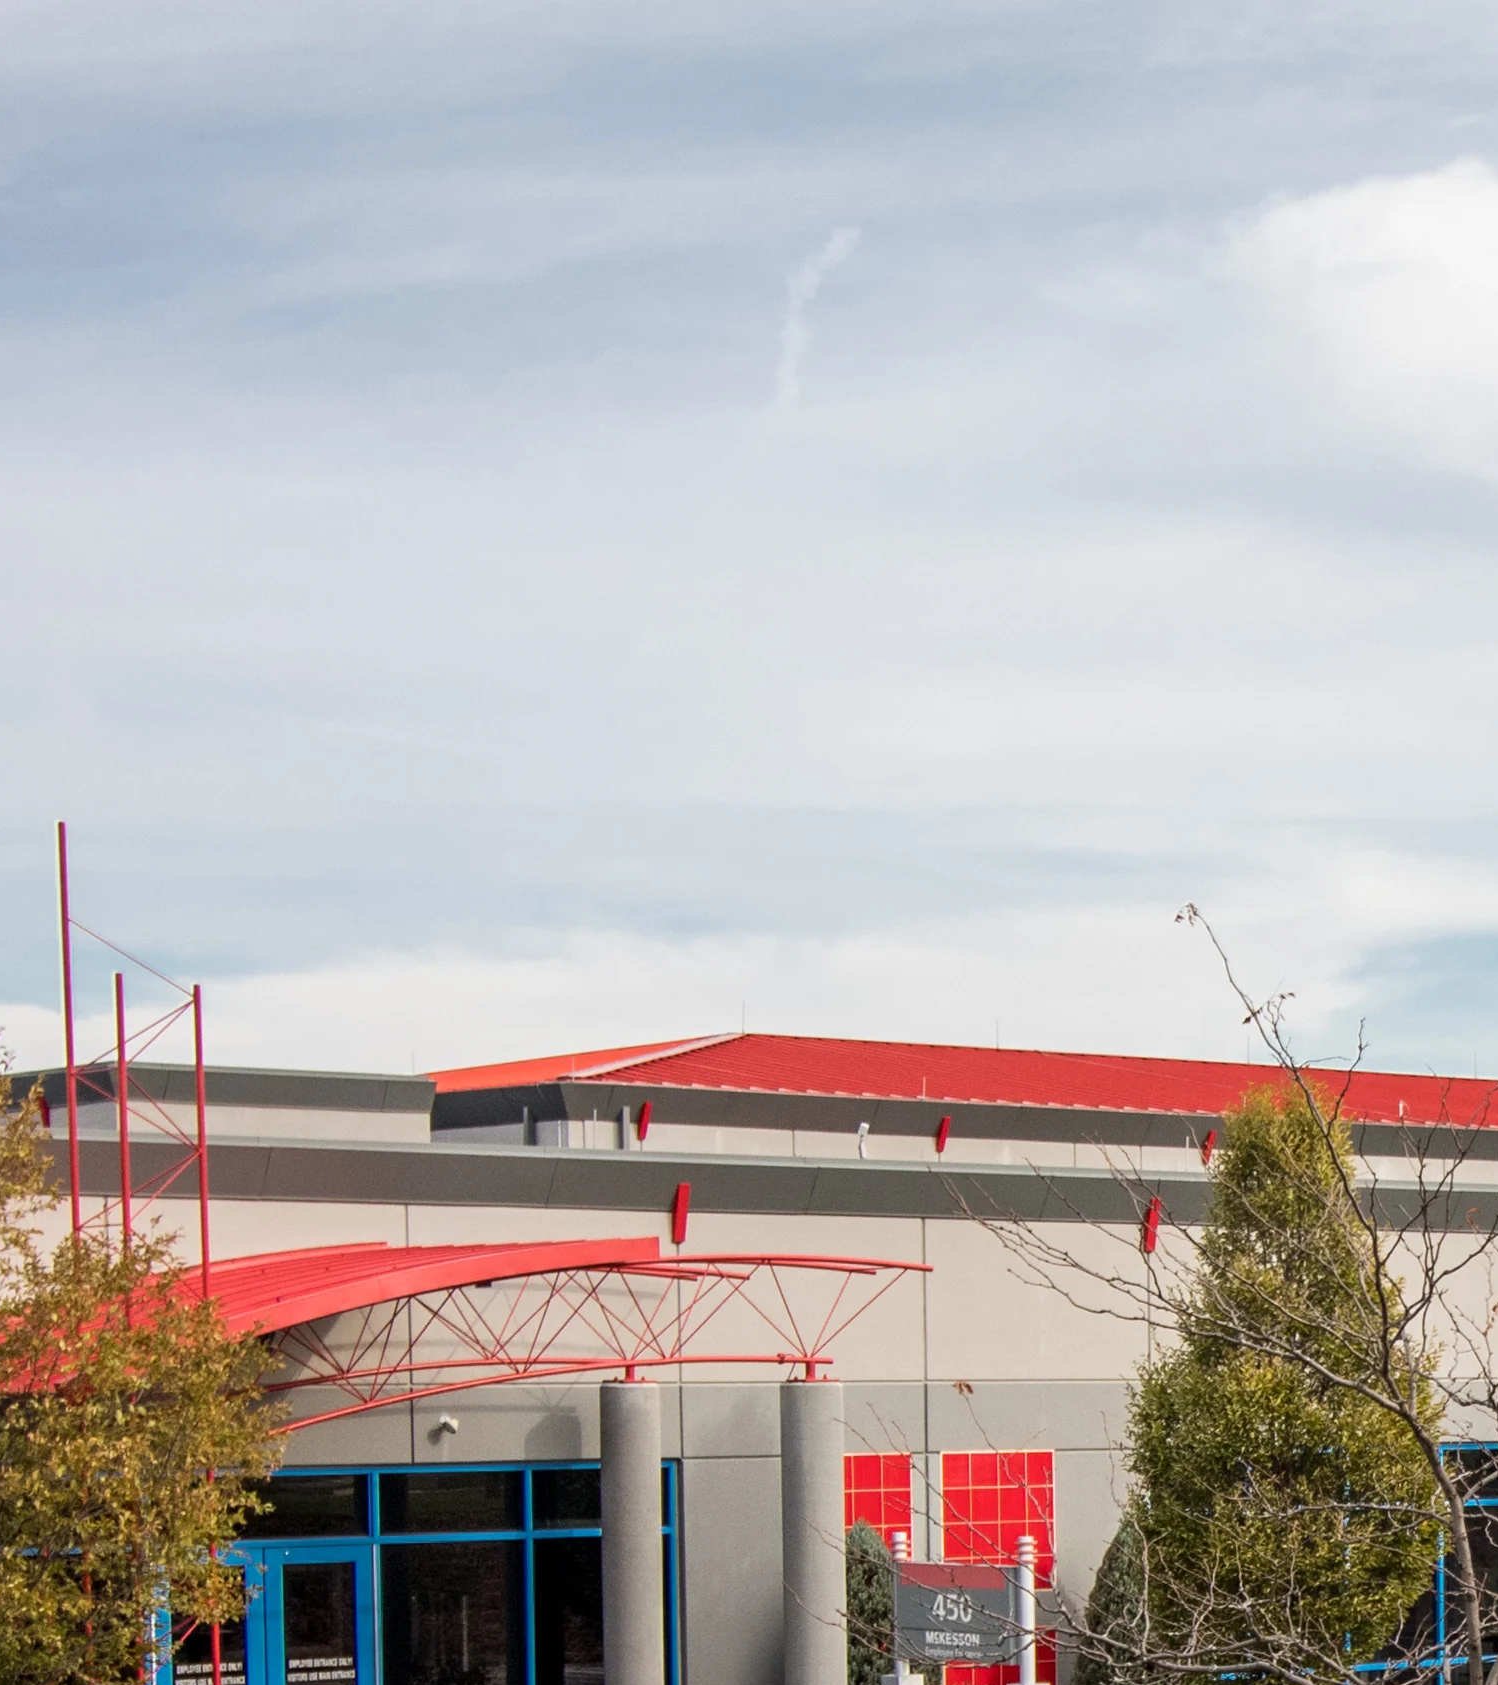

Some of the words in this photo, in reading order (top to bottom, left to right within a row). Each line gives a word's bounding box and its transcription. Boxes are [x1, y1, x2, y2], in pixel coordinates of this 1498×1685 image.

[932, 1593, 972, 1623] 450
[314, 1658, 338, 1667] ENTRANCE
[332, 1669, 356, 1679] ENTRANCE
